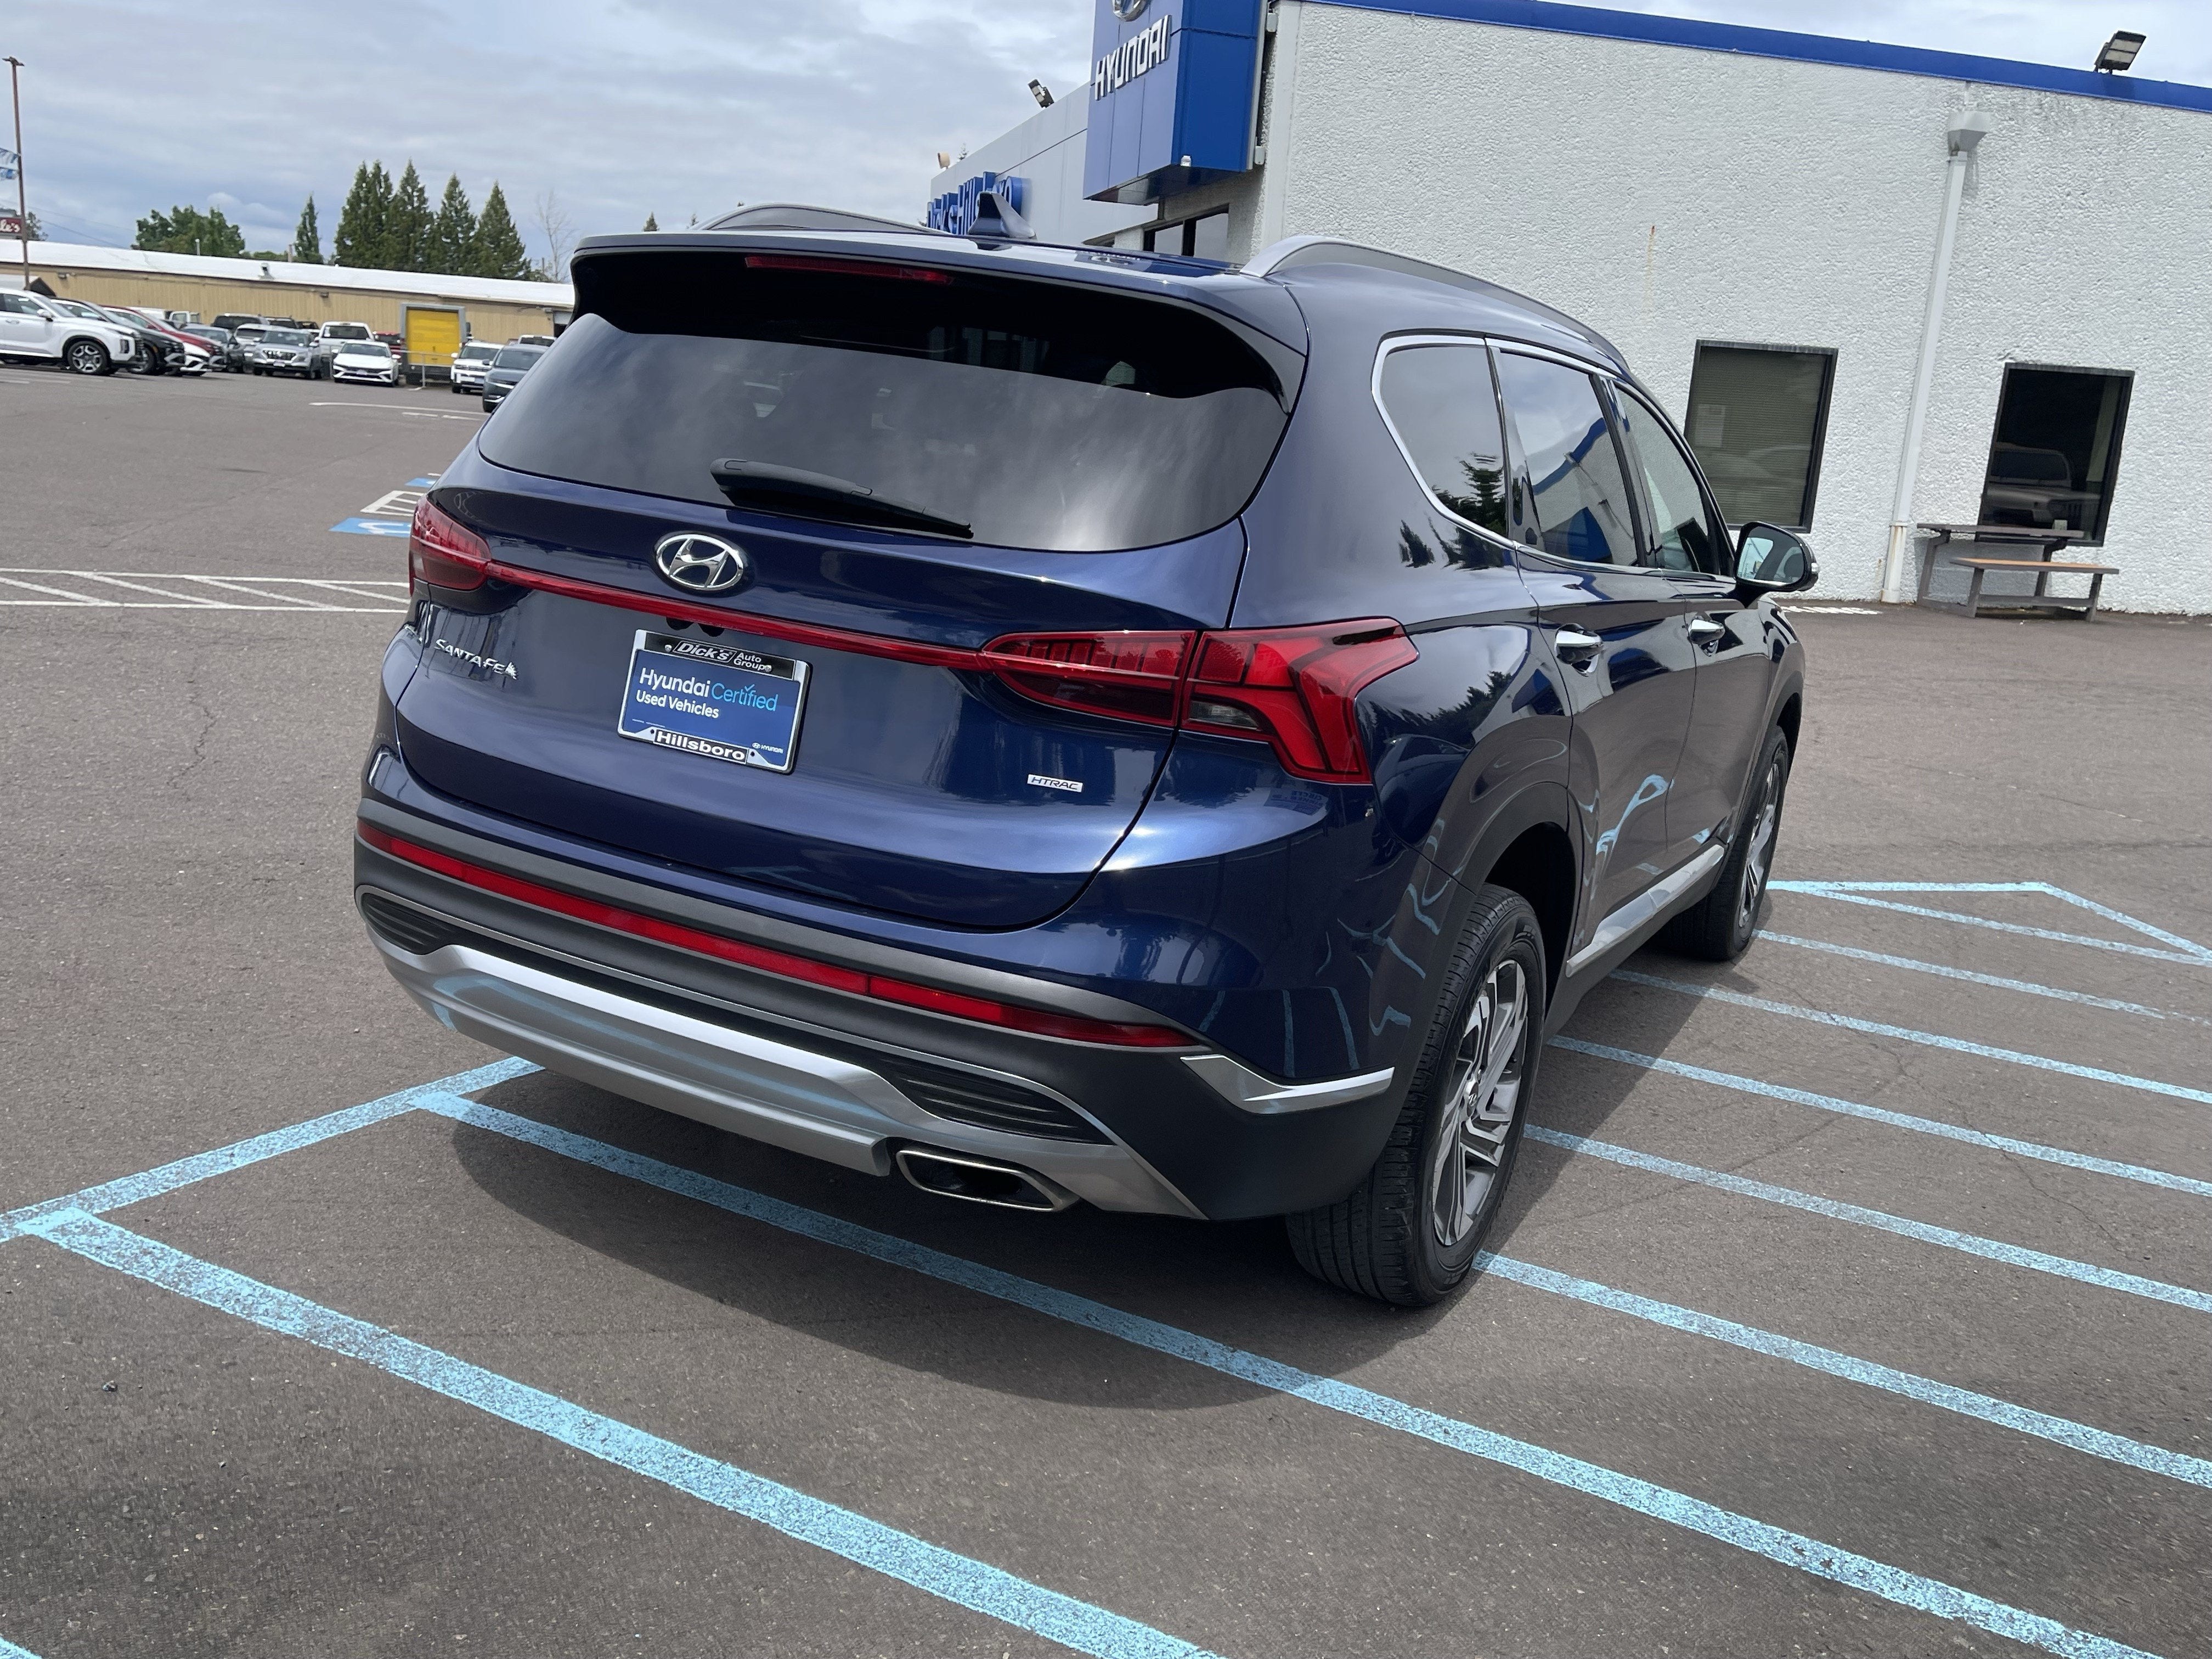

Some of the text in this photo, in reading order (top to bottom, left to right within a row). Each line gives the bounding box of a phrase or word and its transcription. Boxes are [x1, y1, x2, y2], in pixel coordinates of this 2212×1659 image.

[1095, 14, 1171, 100] HYUNDAI
[957, 171, 1022, 235] Hillo
[434, 639, 506, 675] SANTA FE
[677, 642, 730, 660] Dick's
[733, 658, 766, 671] Group
[737, 653, 762, 663] Auto
[639, 667, 778, 712] Hyundai Certified
[636, 690, 720, 719] Used Vehicles
[657, 731, 746, 760] Hillsboro
[761, 744, 783, 754] HYUNDAI
[1031, 776, 1079, 790] HTRAC
